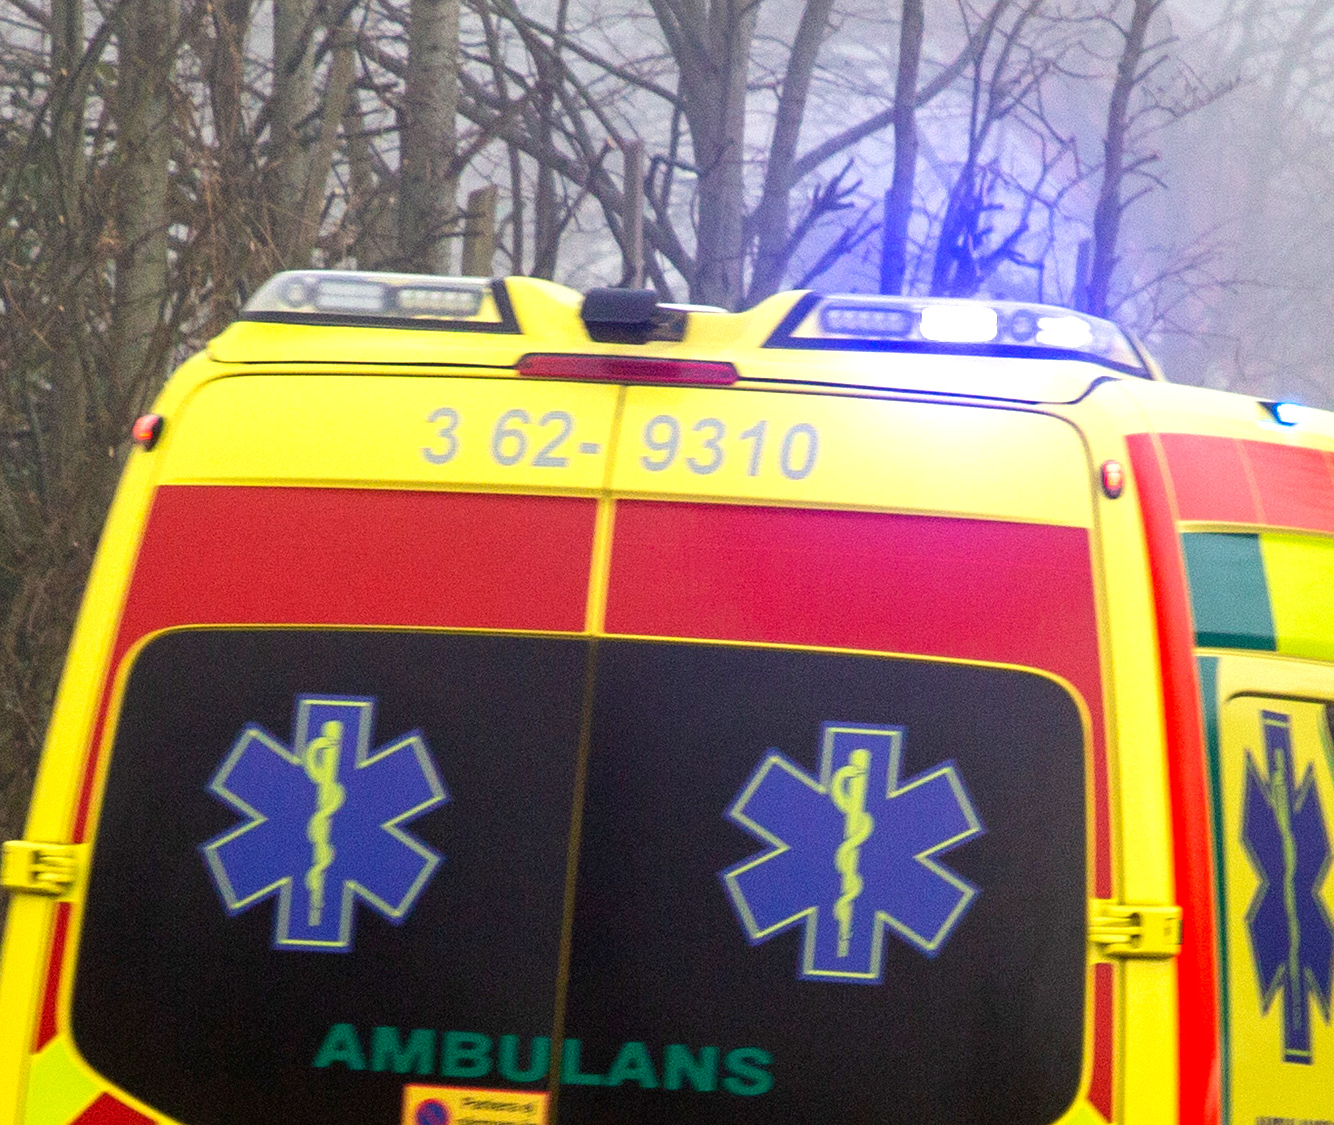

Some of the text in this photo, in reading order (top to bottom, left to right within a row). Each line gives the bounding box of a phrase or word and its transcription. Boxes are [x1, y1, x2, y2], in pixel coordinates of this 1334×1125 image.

[420, 406, 820, 481] 3 62- 9310
[313, 1022, 775, 1097] AMBULANS
